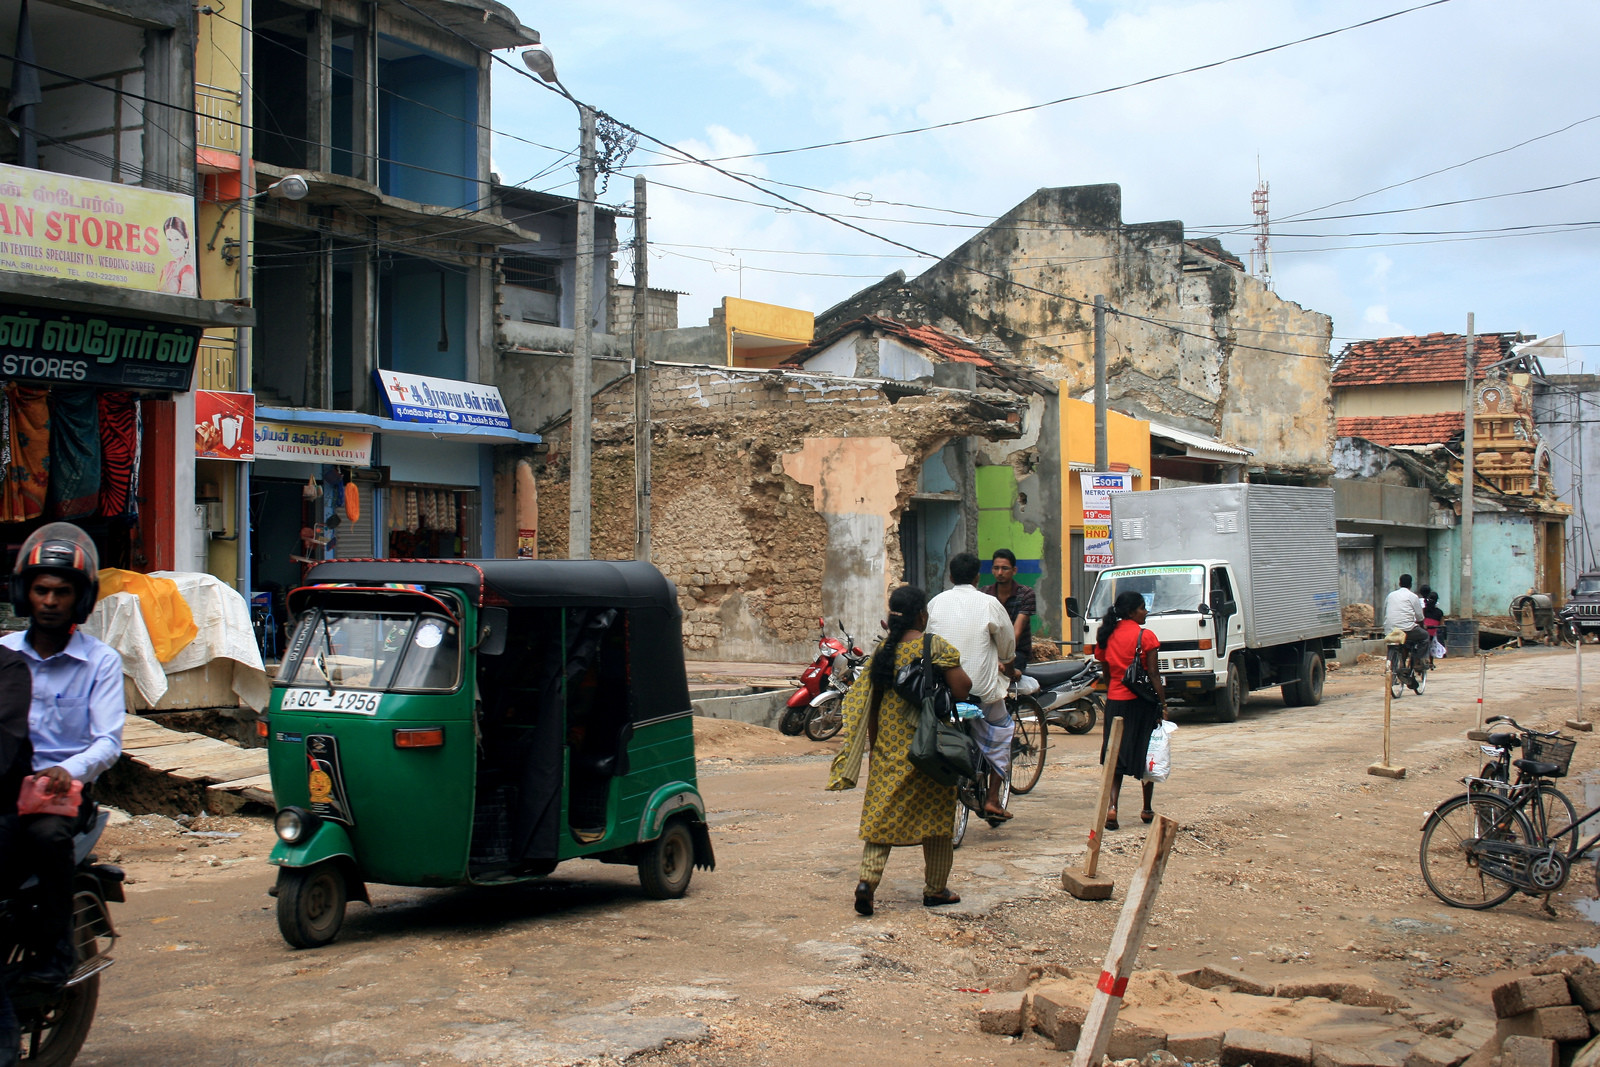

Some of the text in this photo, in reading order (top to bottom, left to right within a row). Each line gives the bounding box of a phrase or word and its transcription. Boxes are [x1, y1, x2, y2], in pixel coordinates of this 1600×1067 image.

[45, 210, 160, 255] STORES
[10, 243, 43, 258] TEXTILES
[46, 248, 84, 265] SPECIALIST
[98, 256, 130, 271] WEDDING
[131, 260, 155, 273] SAREES
[68, 268, 80, 276] TEL
[3, 354, 88, 381] STORES
[495, 418, 509, 428] Sons
[276, 445, 313, 456] SURIYAN
[313, 447, 366, 460] KALANCIYAM
[1092, 476, 1123, 486] ESOFT
[1086, 530, 1107, 538] HND
[1111, 567, 1193, 577] PRAKASH TRANSPORT
[298, 691, 320, 707] QC
[334, 693, 376, 711] 1956
